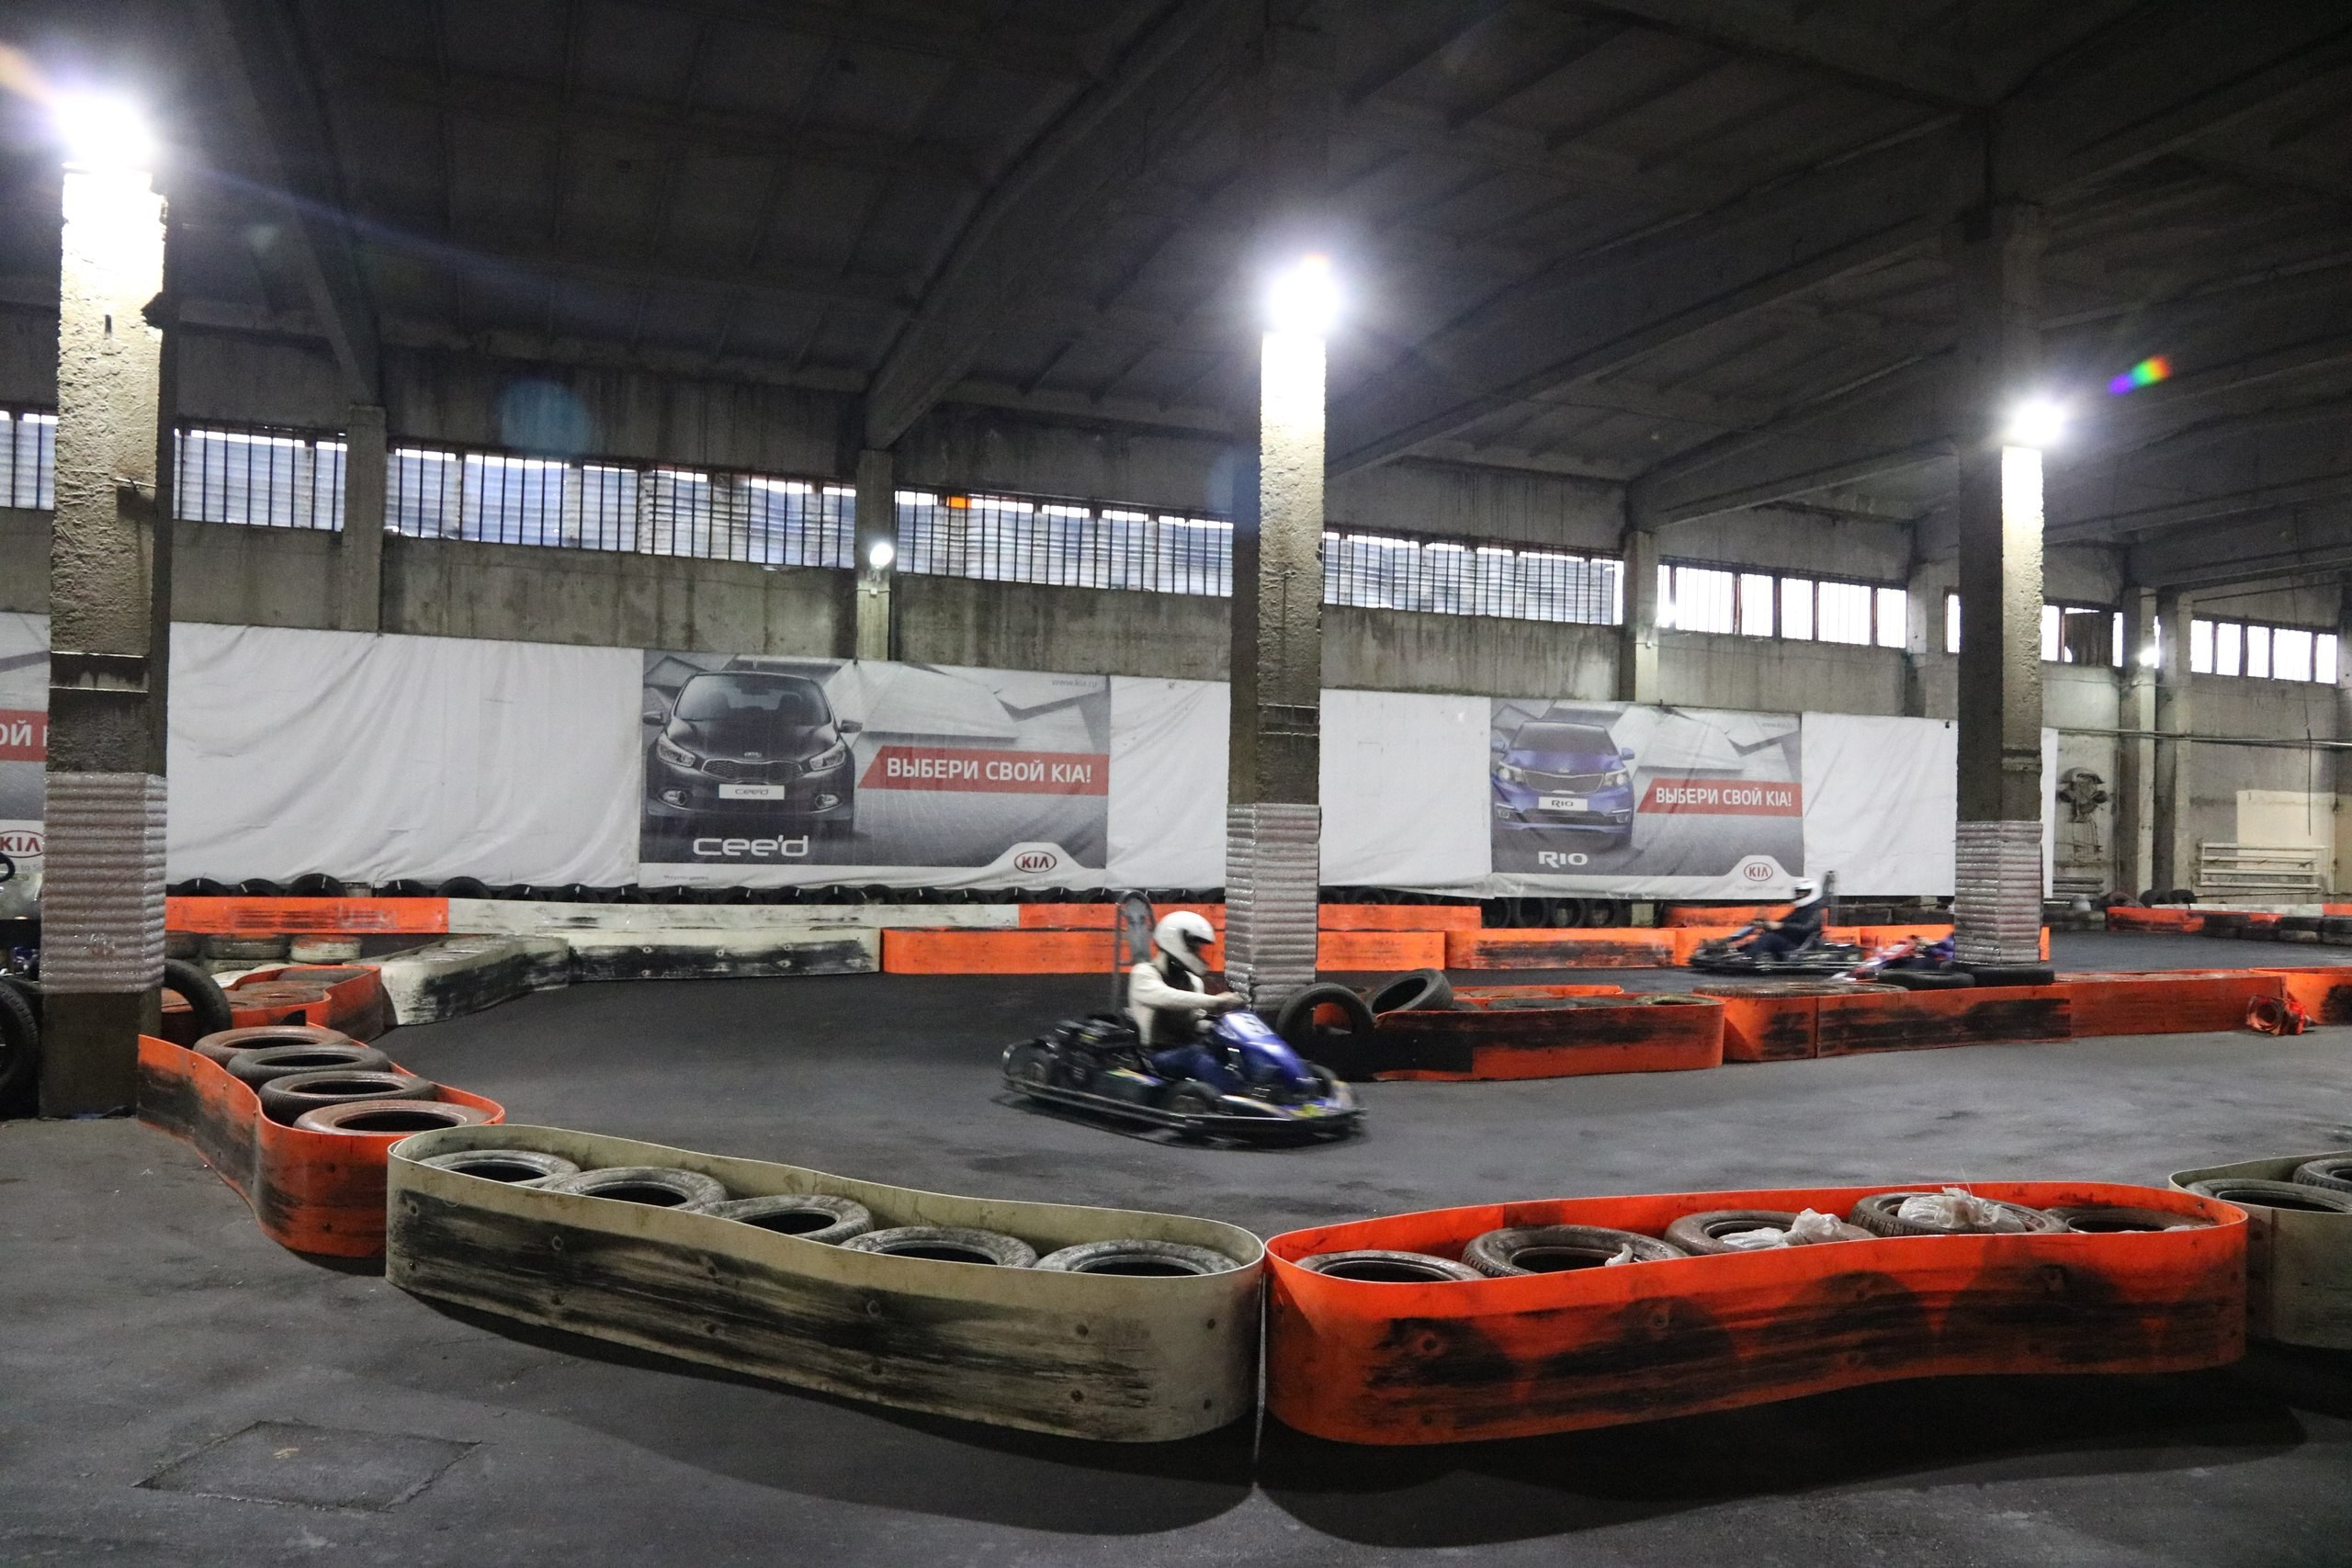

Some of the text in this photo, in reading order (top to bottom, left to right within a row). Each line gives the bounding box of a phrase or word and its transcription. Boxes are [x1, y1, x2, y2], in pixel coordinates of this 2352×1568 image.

[887, 758, 1091, 784] ВЫБЕРИ СВОЙ KIA!
[1551, 799, 1574, 807] RIO
[1656, 787, 1792, 807] ВЫБЕРИ СВОЙ KIA!
[693, 834, 809, 857] cee'd
[1021, 856, 1049, 869] KIA
[1538, 851, 1589, 869] RIO
[1748, 866, 1769, 877] KIA
